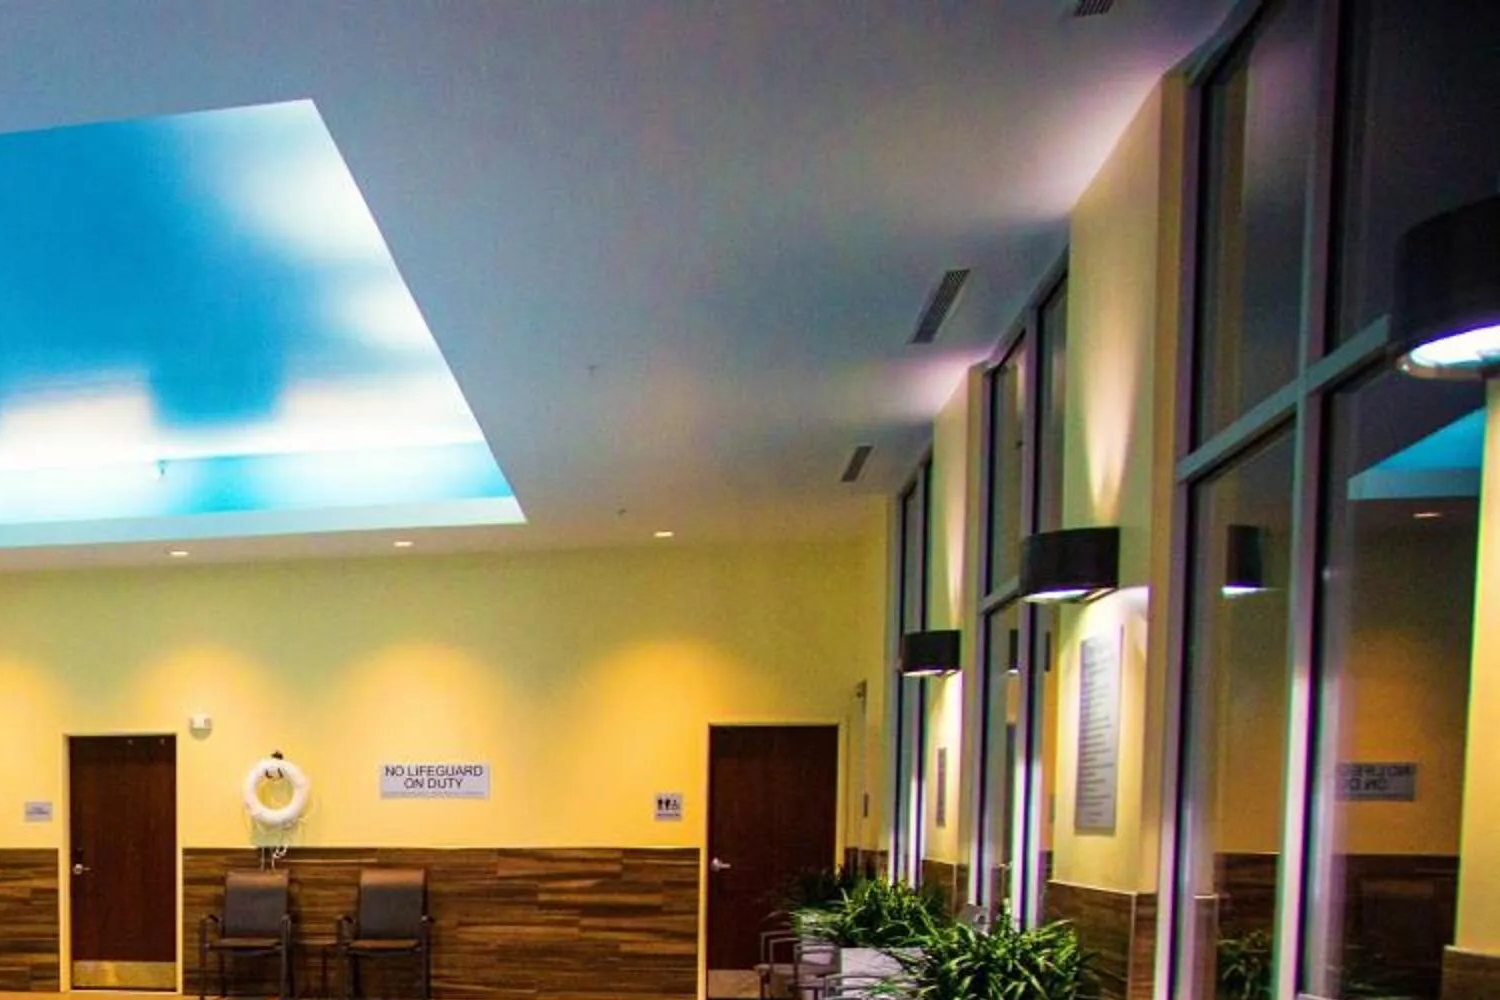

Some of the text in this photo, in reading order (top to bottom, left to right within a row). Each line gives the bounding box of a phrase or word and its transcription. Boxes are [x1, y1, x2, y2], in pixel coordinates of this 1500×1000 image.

[384, 765, 484, 777] NO LIFEGUARD
[404, 778, 464, 789] ON DUTY
